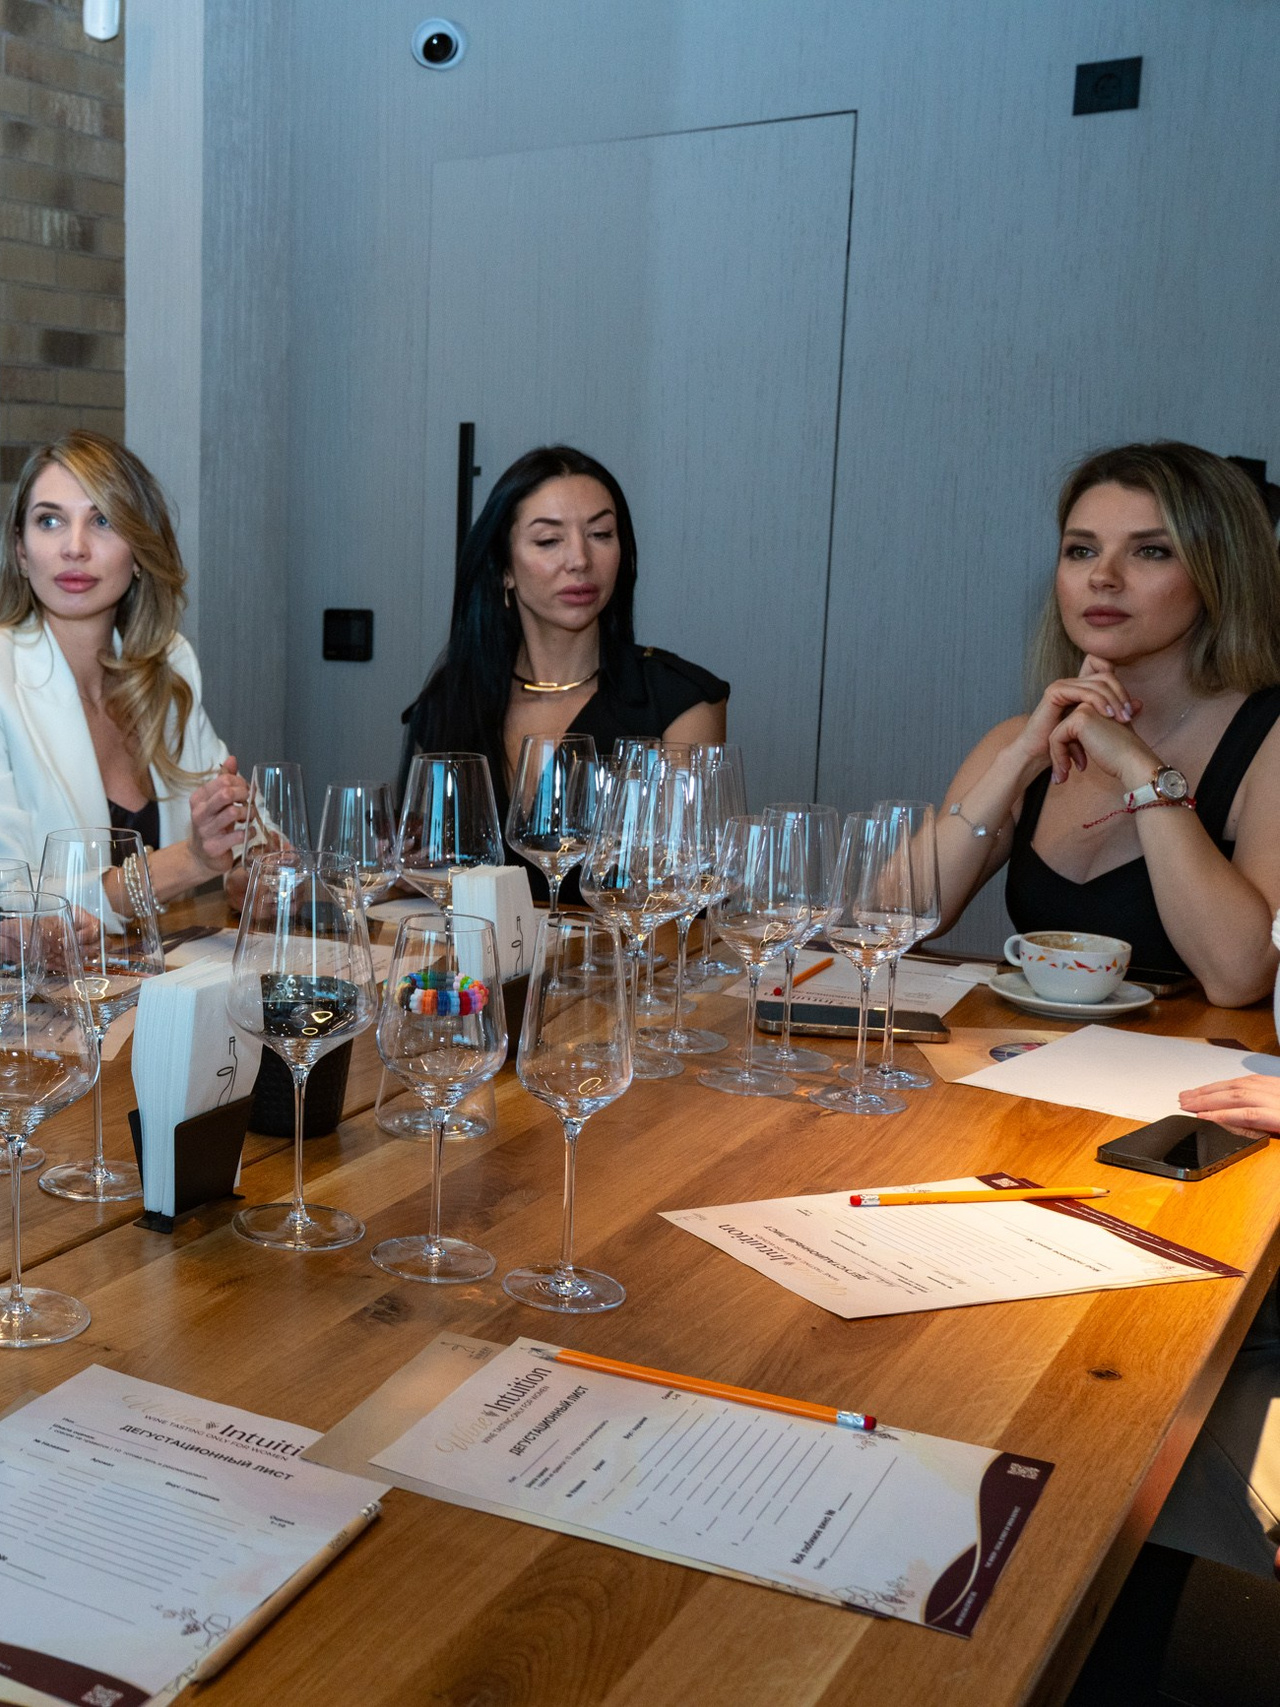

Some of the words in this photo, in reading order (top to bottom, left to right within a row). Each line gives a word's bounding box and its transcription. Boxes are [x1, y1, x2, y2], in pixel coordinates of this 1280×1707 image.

[718, 1224, 788, 1261] Intuition
[484, 1367, 552, 1412] Intuition
[119, 1424, 251, 1468] ДЕГУСТАЦИОННЫЙ
[253, 1465, 294, 1481] ЛИСТ
[144, 1414, 167, 1428] WINE
[169, 1421, 204, 1437] TASTING
[205, 1432, 230, 1446] ONLY
[230, 1441, 250, 1450] FOR
[251, 1446, 289, 1462] WOMEN
[219, 1423, 306, 1457] Intuiti
